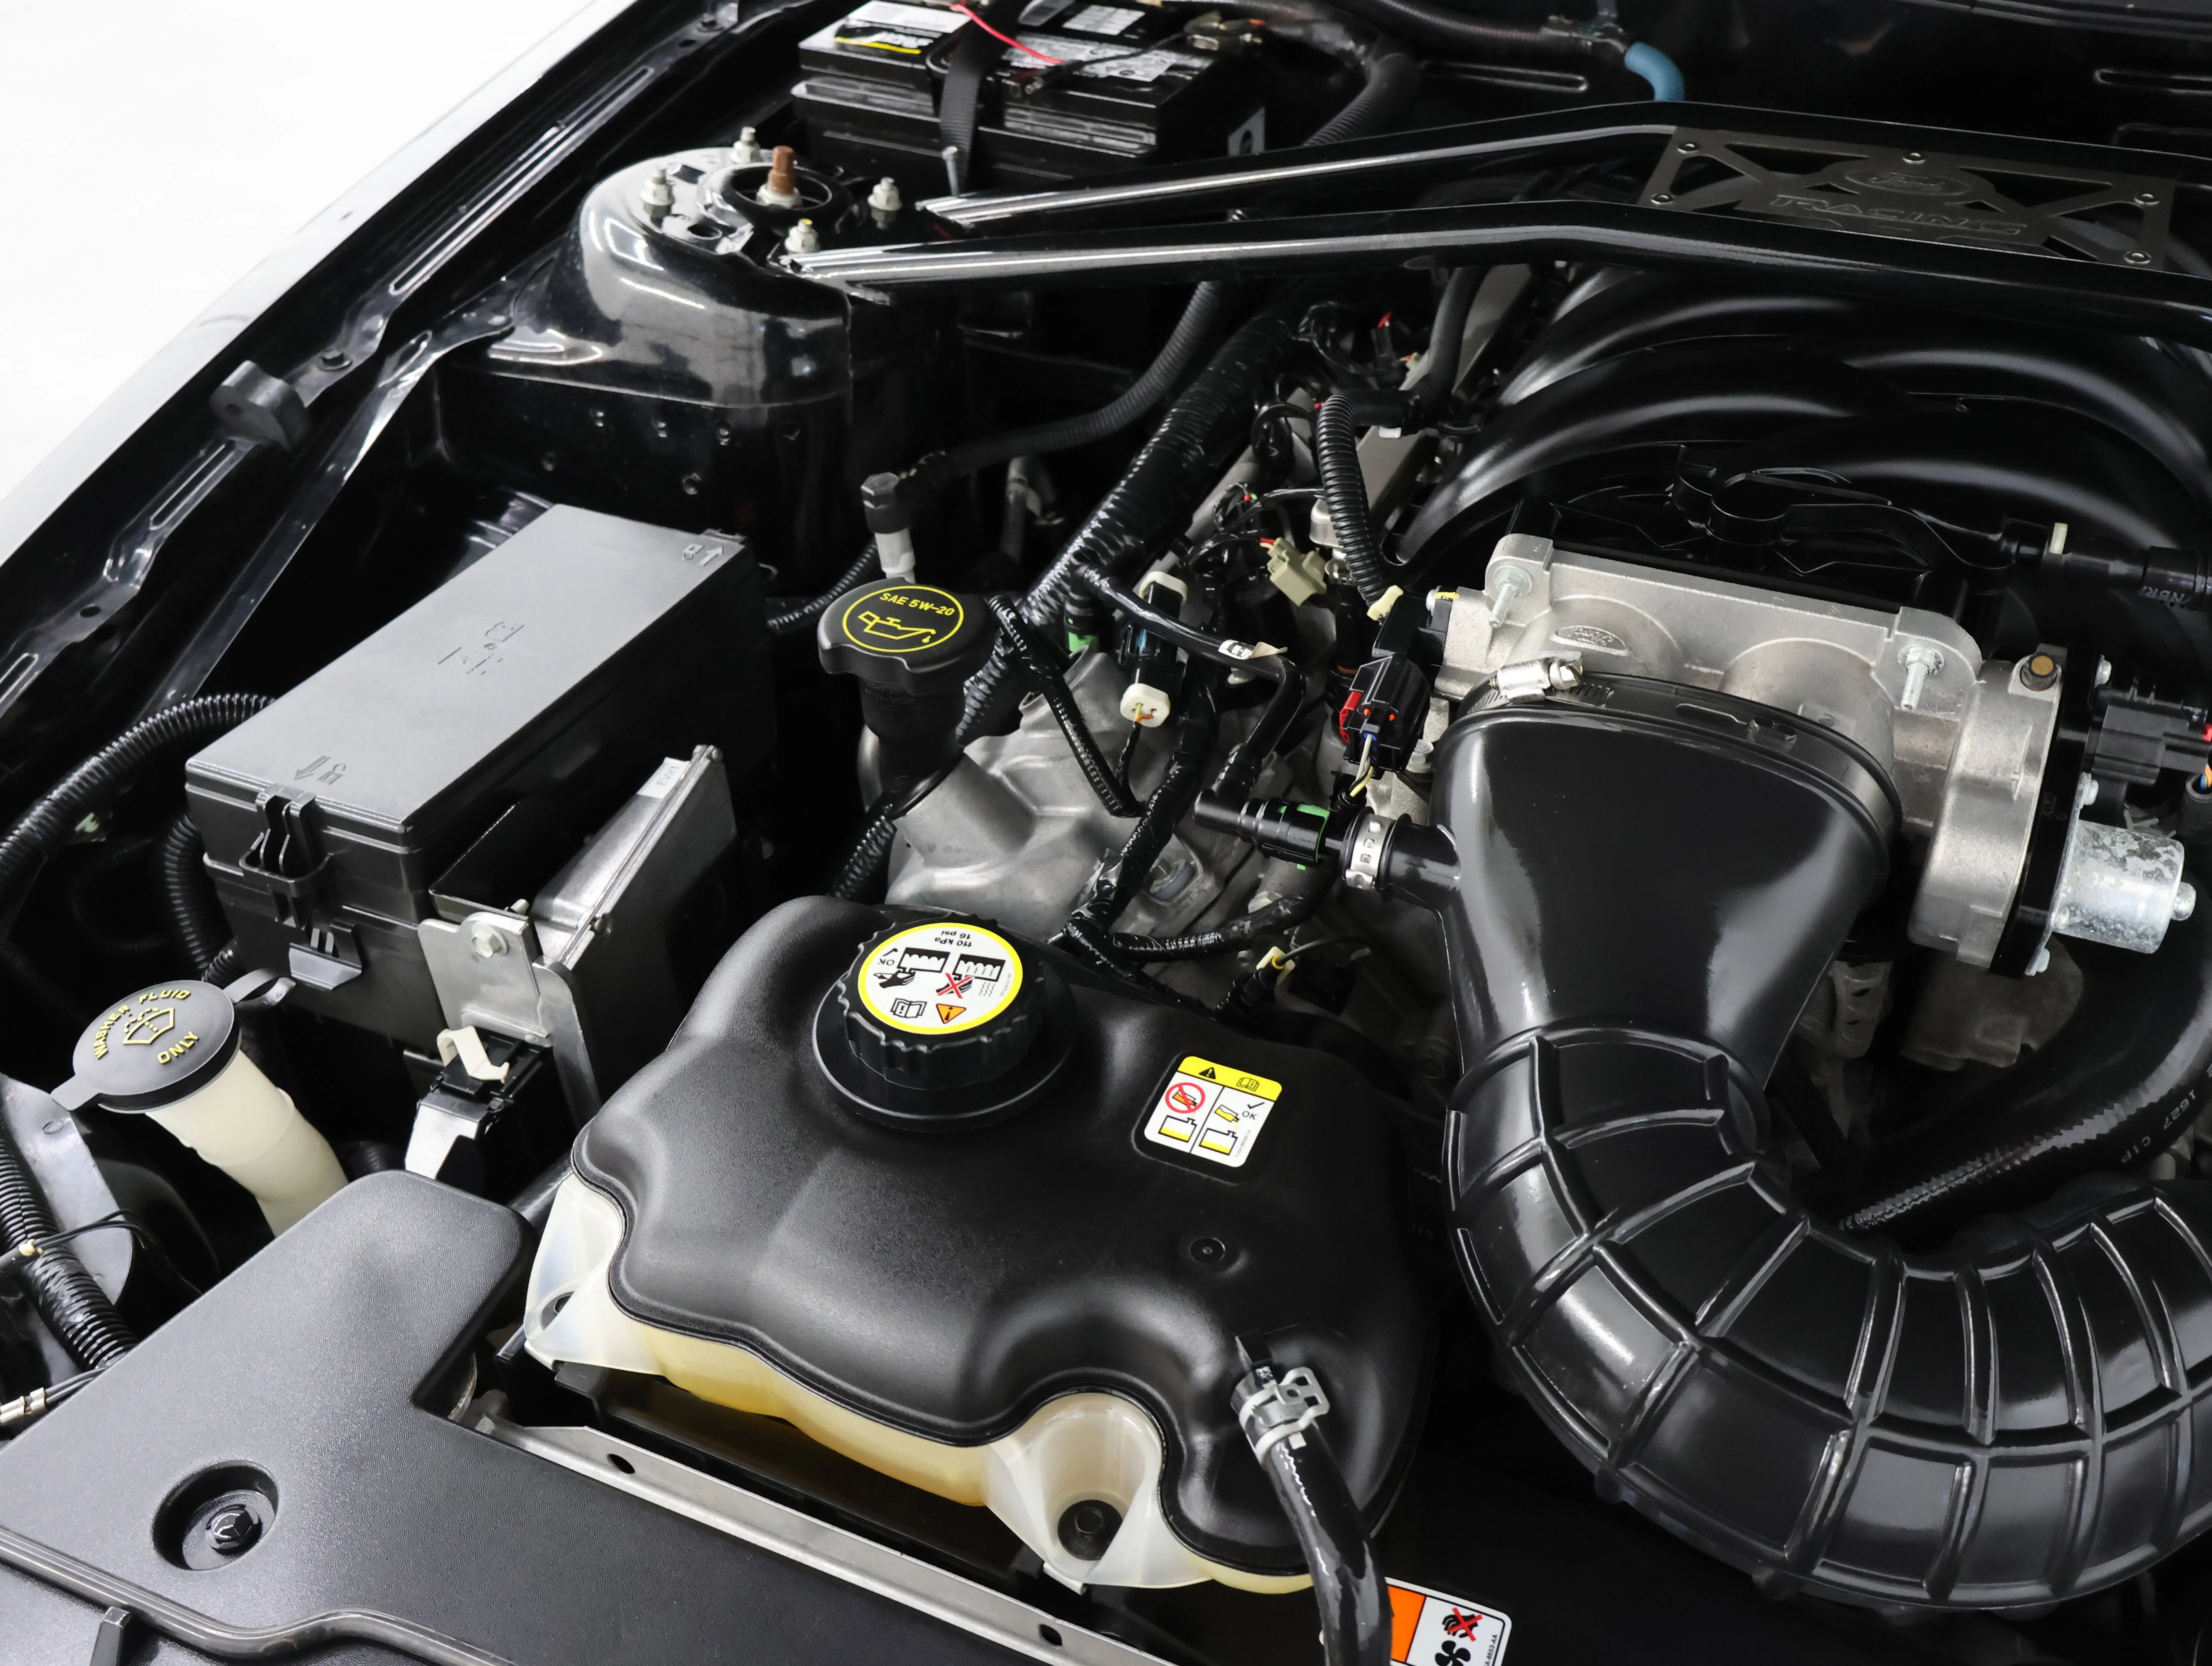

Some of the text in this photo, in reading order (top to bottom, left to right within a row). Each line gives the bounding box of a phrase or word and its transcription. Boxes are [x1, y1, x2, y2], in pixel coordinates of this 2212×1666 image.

[1868, 172, 1945, 191] Ford
[1770, 194, 2027, 234] RACING
[880, 592, 955, 617] SAE 5W-20
[934, 937, 954, 945] kPa
[877, 958, 895, 966] OK
[93, 990, 191, 1060] WASHER FLUID
[157, 1030, 199, 1064] ONLY
[1242, 1110, 1258, 1120] OK
[2163, 1090, 2196, 1130] 1627
